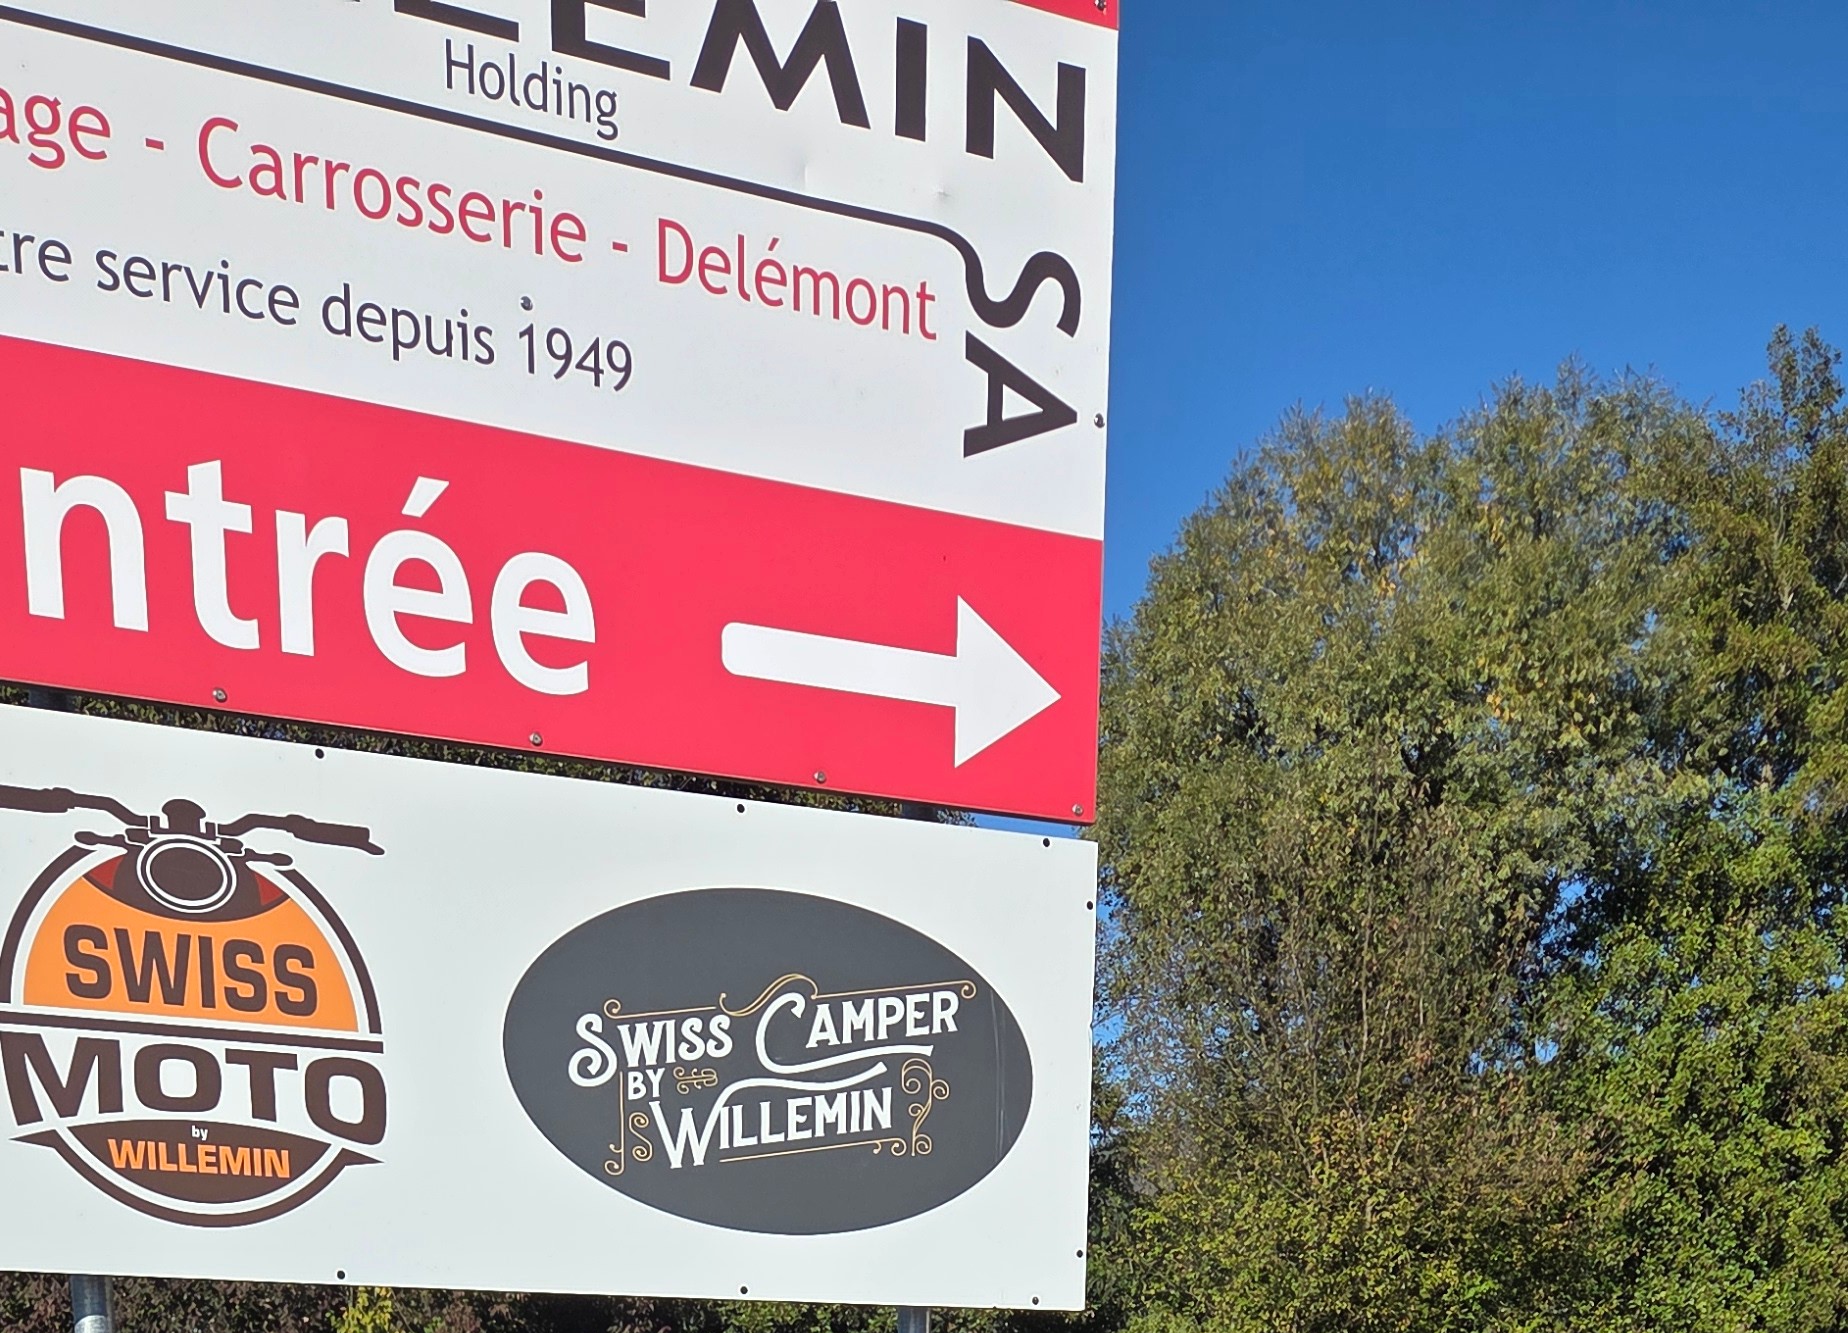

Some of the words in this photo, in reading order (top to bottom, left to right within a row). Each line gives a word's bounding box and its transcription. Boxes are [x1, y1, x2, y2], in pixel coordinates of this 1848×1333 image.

[445, 38, 619, 141] Holding
[145, 137, 164, 151] -
[198, 116, 588, 264] Carrosserie
[611, 240, 629, 254] -
[657, 217, 938, 341] Delémont
[95, 249, 300, 326] service
[321, 282, 495, 368] depuis
[520, 322, 635, 392] 1949
[962, 250, 1082, 459] SA
[63, 924, 318, 1017] SWISS
[0, 1031, 387, 1145] MOTO
[568, 1012, 733, 1087] SWISS
[755, 991, 961, 1075] CAMPER
[627, 1067, 666, 1101] BY
[107, 1138, 290, 1179] WILLEMIN
[191, 1125, 208, 1141] by
[648, 1061, 893, 1170] WILLEMIN
